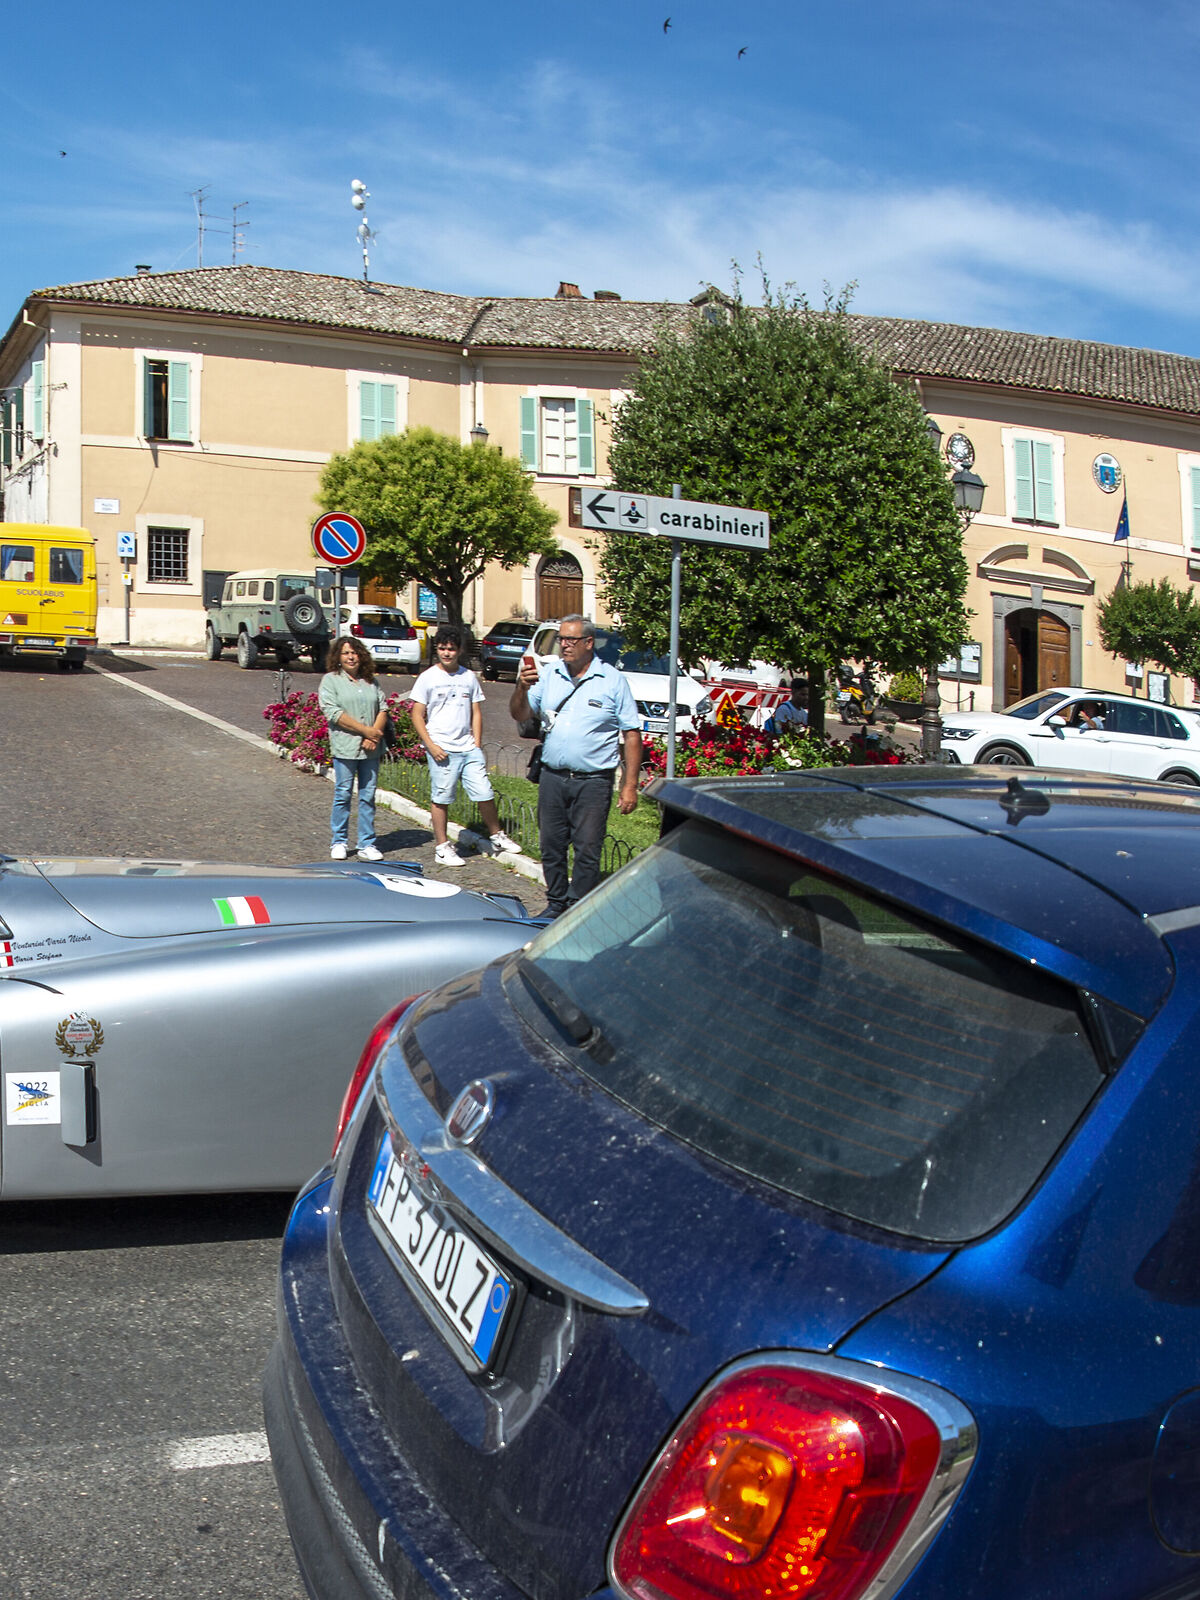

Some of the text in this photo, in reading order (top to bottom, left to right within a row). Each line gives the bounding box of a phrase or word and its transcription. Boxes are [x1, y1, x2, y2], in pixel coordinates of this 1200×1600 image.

[660, 512, 765, 538] carabinieri
[16, 589, 65, 597] SCUOLABUS
[68, 933, 92, 943] Nicola
[36, 952, 63, 960] Stefano
[18, 1081, 48, 1092] 2022
